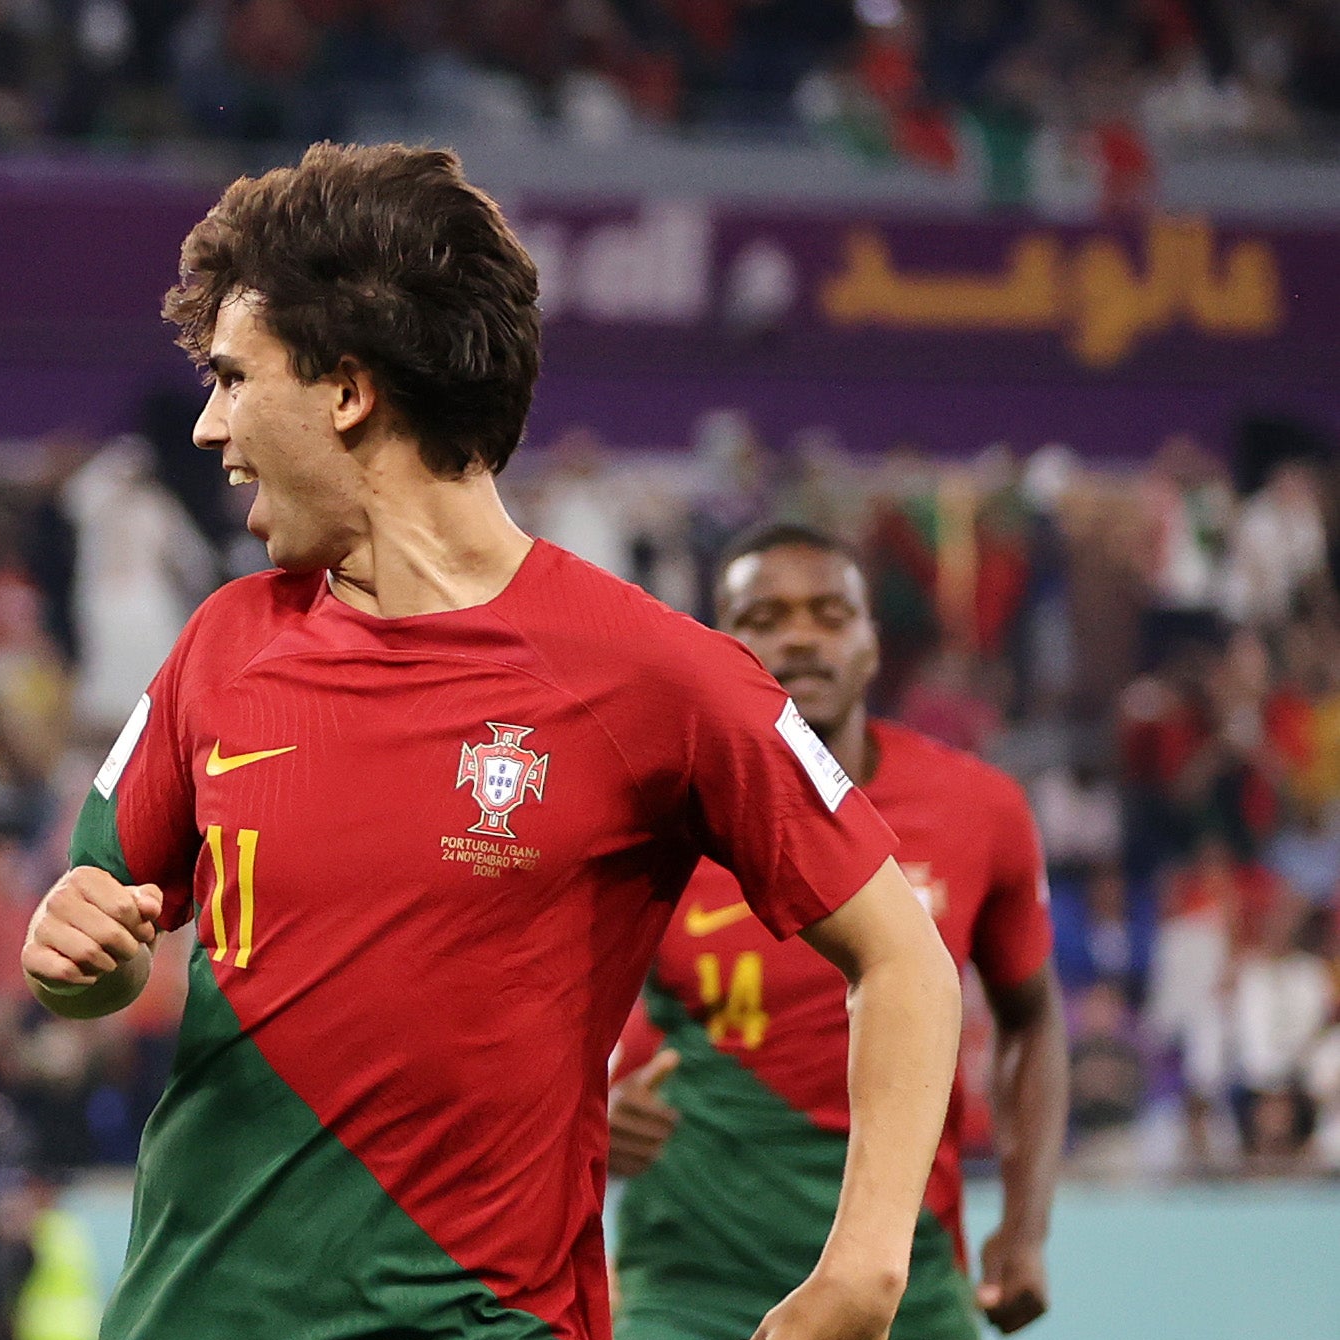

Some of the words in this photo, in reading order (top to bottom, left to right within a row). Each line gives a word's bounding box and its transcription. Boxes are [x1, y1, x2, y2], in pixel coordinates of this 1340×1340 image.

[206, 825, 259, 968] 11
[442, 849, 454, 860] 24
[457, 851, 510, 868] NOVEMBRO
[695, 950, 768, 1049] 14
